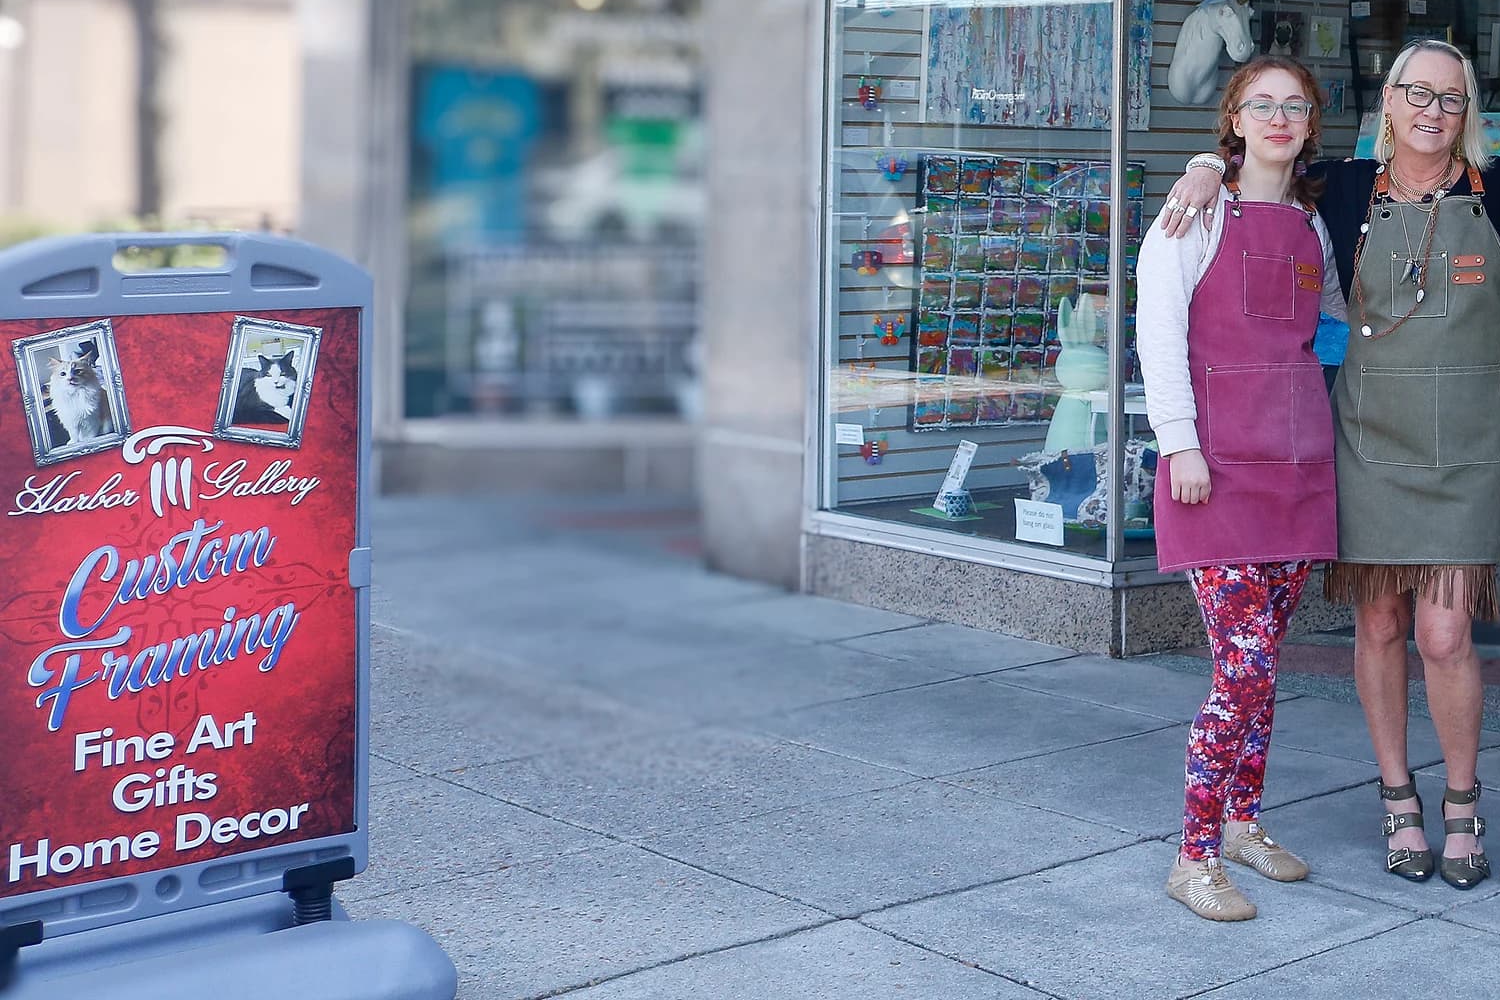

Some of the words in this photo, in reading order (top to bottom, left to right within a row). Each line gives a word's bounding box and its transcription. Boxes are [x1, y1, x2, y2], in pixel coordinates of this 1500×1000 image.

[8, 470, 140, 516] Harbor
[199, 460, 321, 505] Gallery
[59, 518, 277, 638] Custom
[27, 602, 301, 731] Framing
[74, 727, 174, 772] Fine
[186, 712, 257, 754] Art
[112, 765, 218, 812] Gifts
[8, 831, 160, 882] Home
[175, 803, 309, 851] Decor
